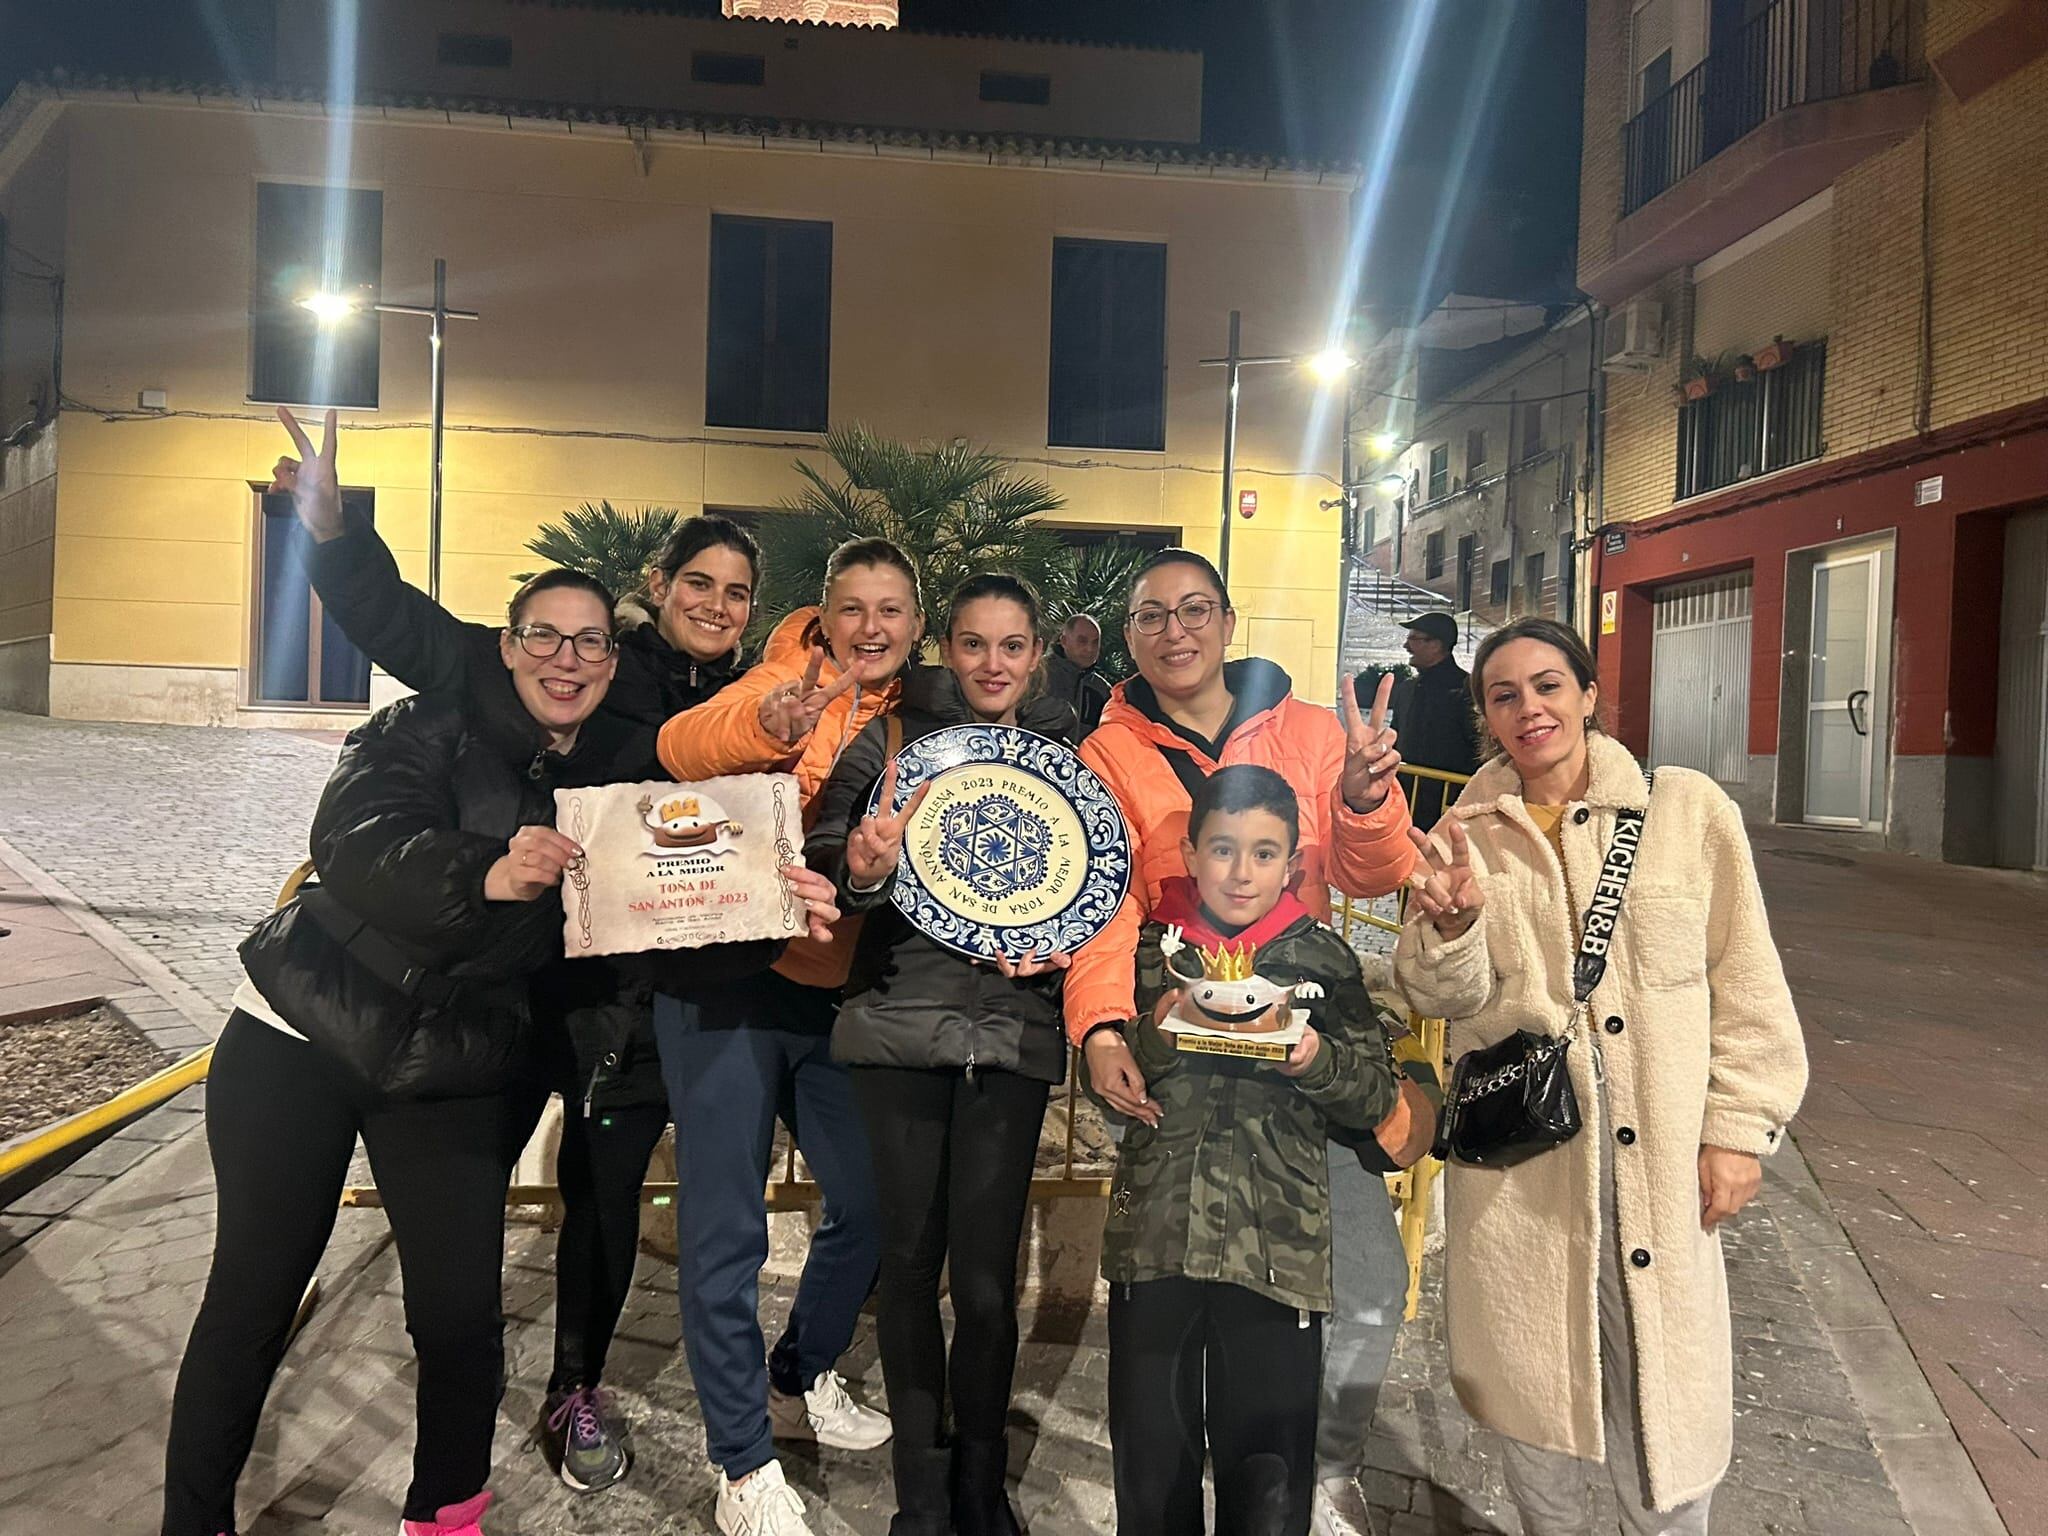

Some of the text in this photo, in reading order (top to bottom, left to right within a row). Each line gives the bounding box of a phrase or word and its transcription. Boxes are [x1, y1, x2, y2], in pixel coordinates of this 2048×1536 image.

[920, 777, 1072, 915] PREMIO A LA MEJOR TOÑA DE SAN ANTÓN VILLENA 2023
[657, 858, 711, 868] PREMIO
[679, 865, 726, 875] MEJOR
[659, 879, 718, 894] TOÑA DE
[628, 901, 655, 913] SAN
[659, 894, 705, 910] ANTÓN
[718, 893, 749, 905] 2023
